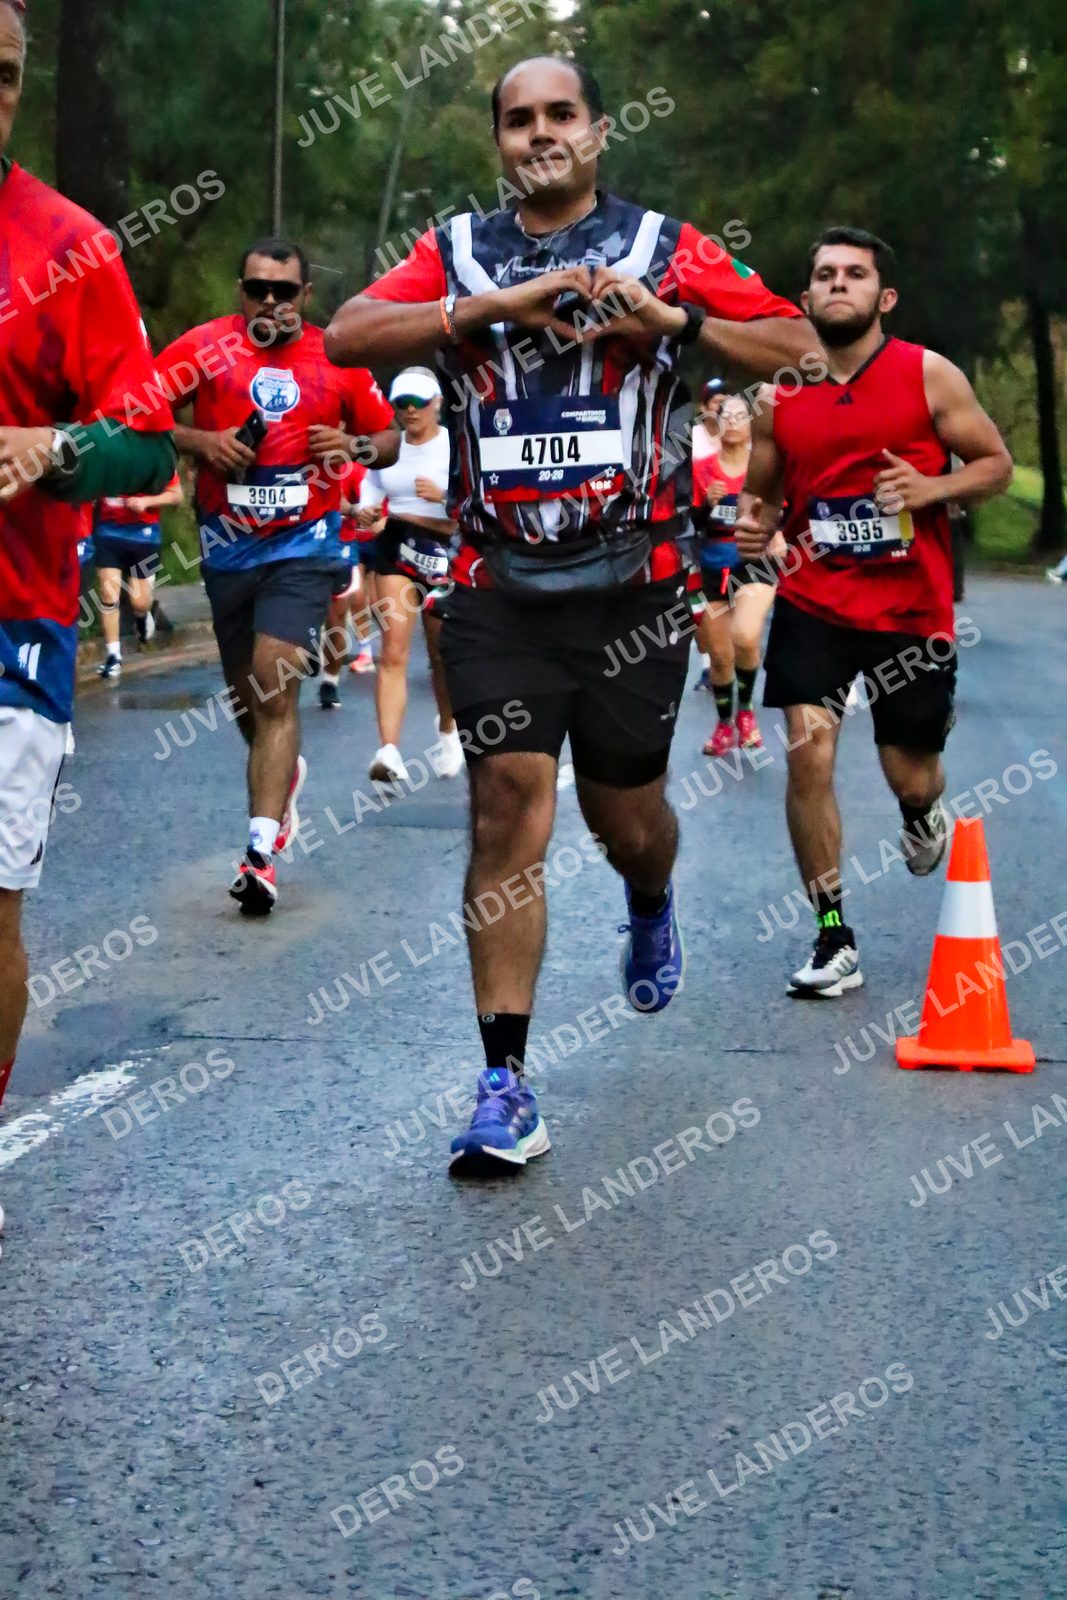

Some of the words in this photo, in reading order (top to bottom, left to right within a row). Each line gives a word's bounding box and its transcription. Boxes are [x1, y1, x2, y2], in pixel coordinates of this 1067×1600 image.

[521, 435, 581, 465] 4704
[249, 487, 287, 505] 3904
[836, 520, 883, 542] 3935
